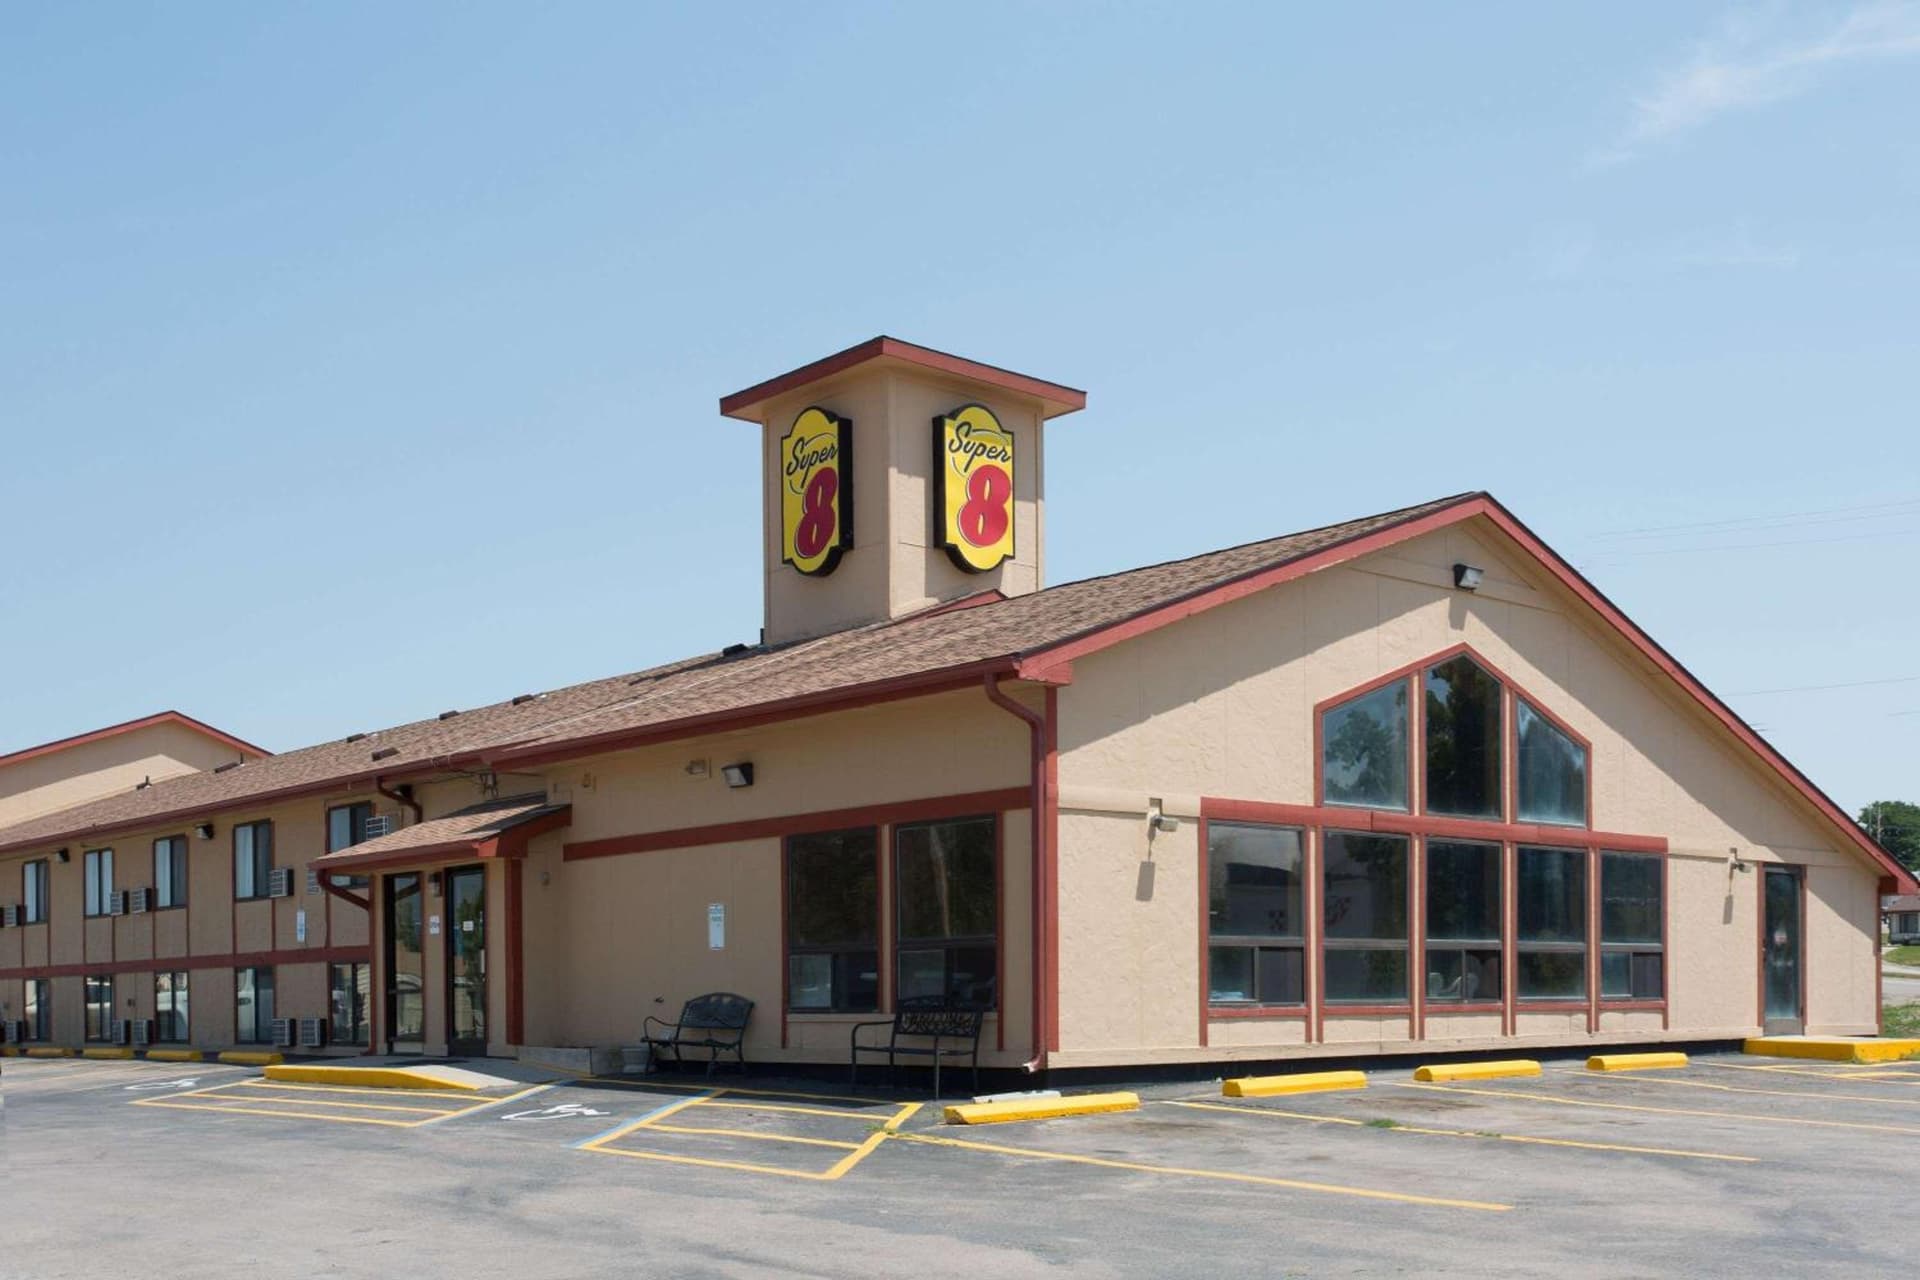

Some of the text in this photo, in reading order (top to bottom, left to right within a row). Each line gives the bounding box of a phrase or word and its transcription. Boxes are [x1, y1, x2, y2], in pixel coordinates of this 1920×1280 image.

[786, 436, 838, 488] Super
[948, 421, 1011, 473] Super
[795, 466, 838, 559] 8
[958, 464, 1011, 548] 8
